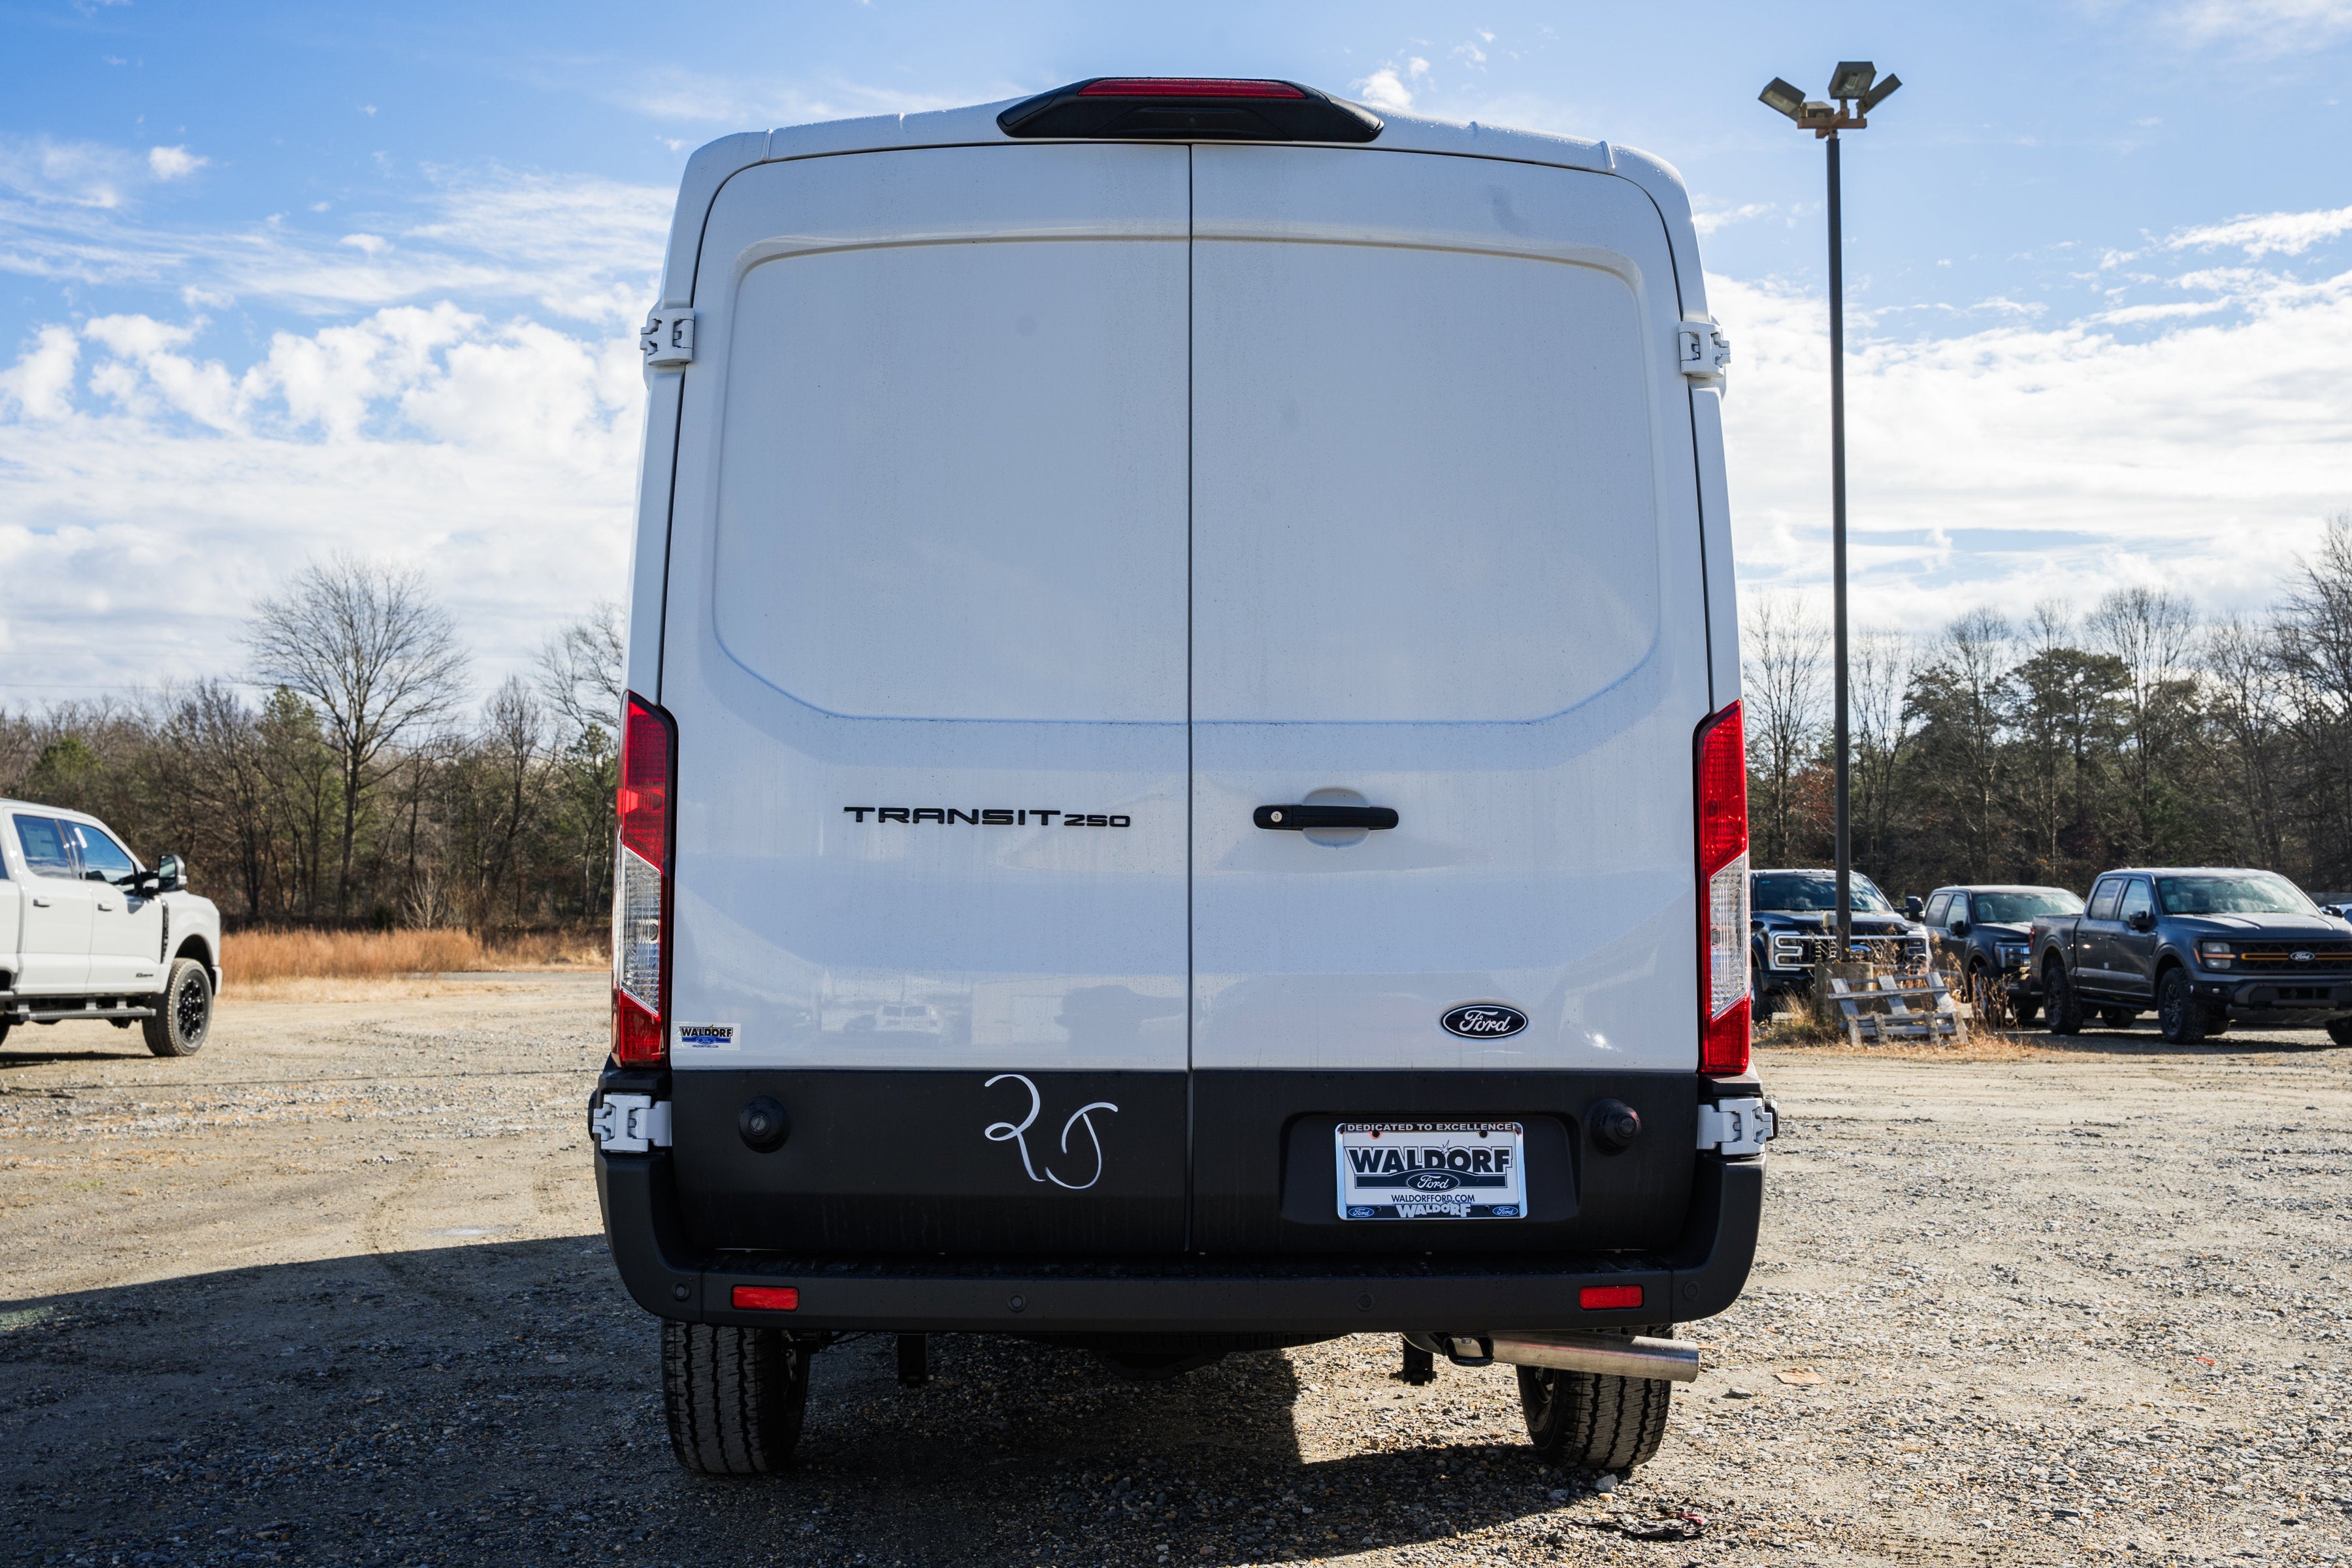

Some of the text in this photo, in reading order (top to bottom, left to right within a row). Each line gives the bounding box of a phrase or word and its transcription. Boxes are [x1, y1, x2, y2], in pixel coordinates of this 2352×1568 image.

[843, 806, 1131, 828] TRANSIT 250
[1459, 1010, 1511, 1032] Ford
[681, 1027, 732, 1037] WALDORF
[1347, 1148, 1511, 1173] WALDORF
[1416, 1175, 1450, 1189] Ford
[1391, 1194, 1475, 1203] WALDORFFORD.COM
[1395, 1203, 1471, 1218] WALDORF
[1497, 1207, 1514, 1215] Ford
